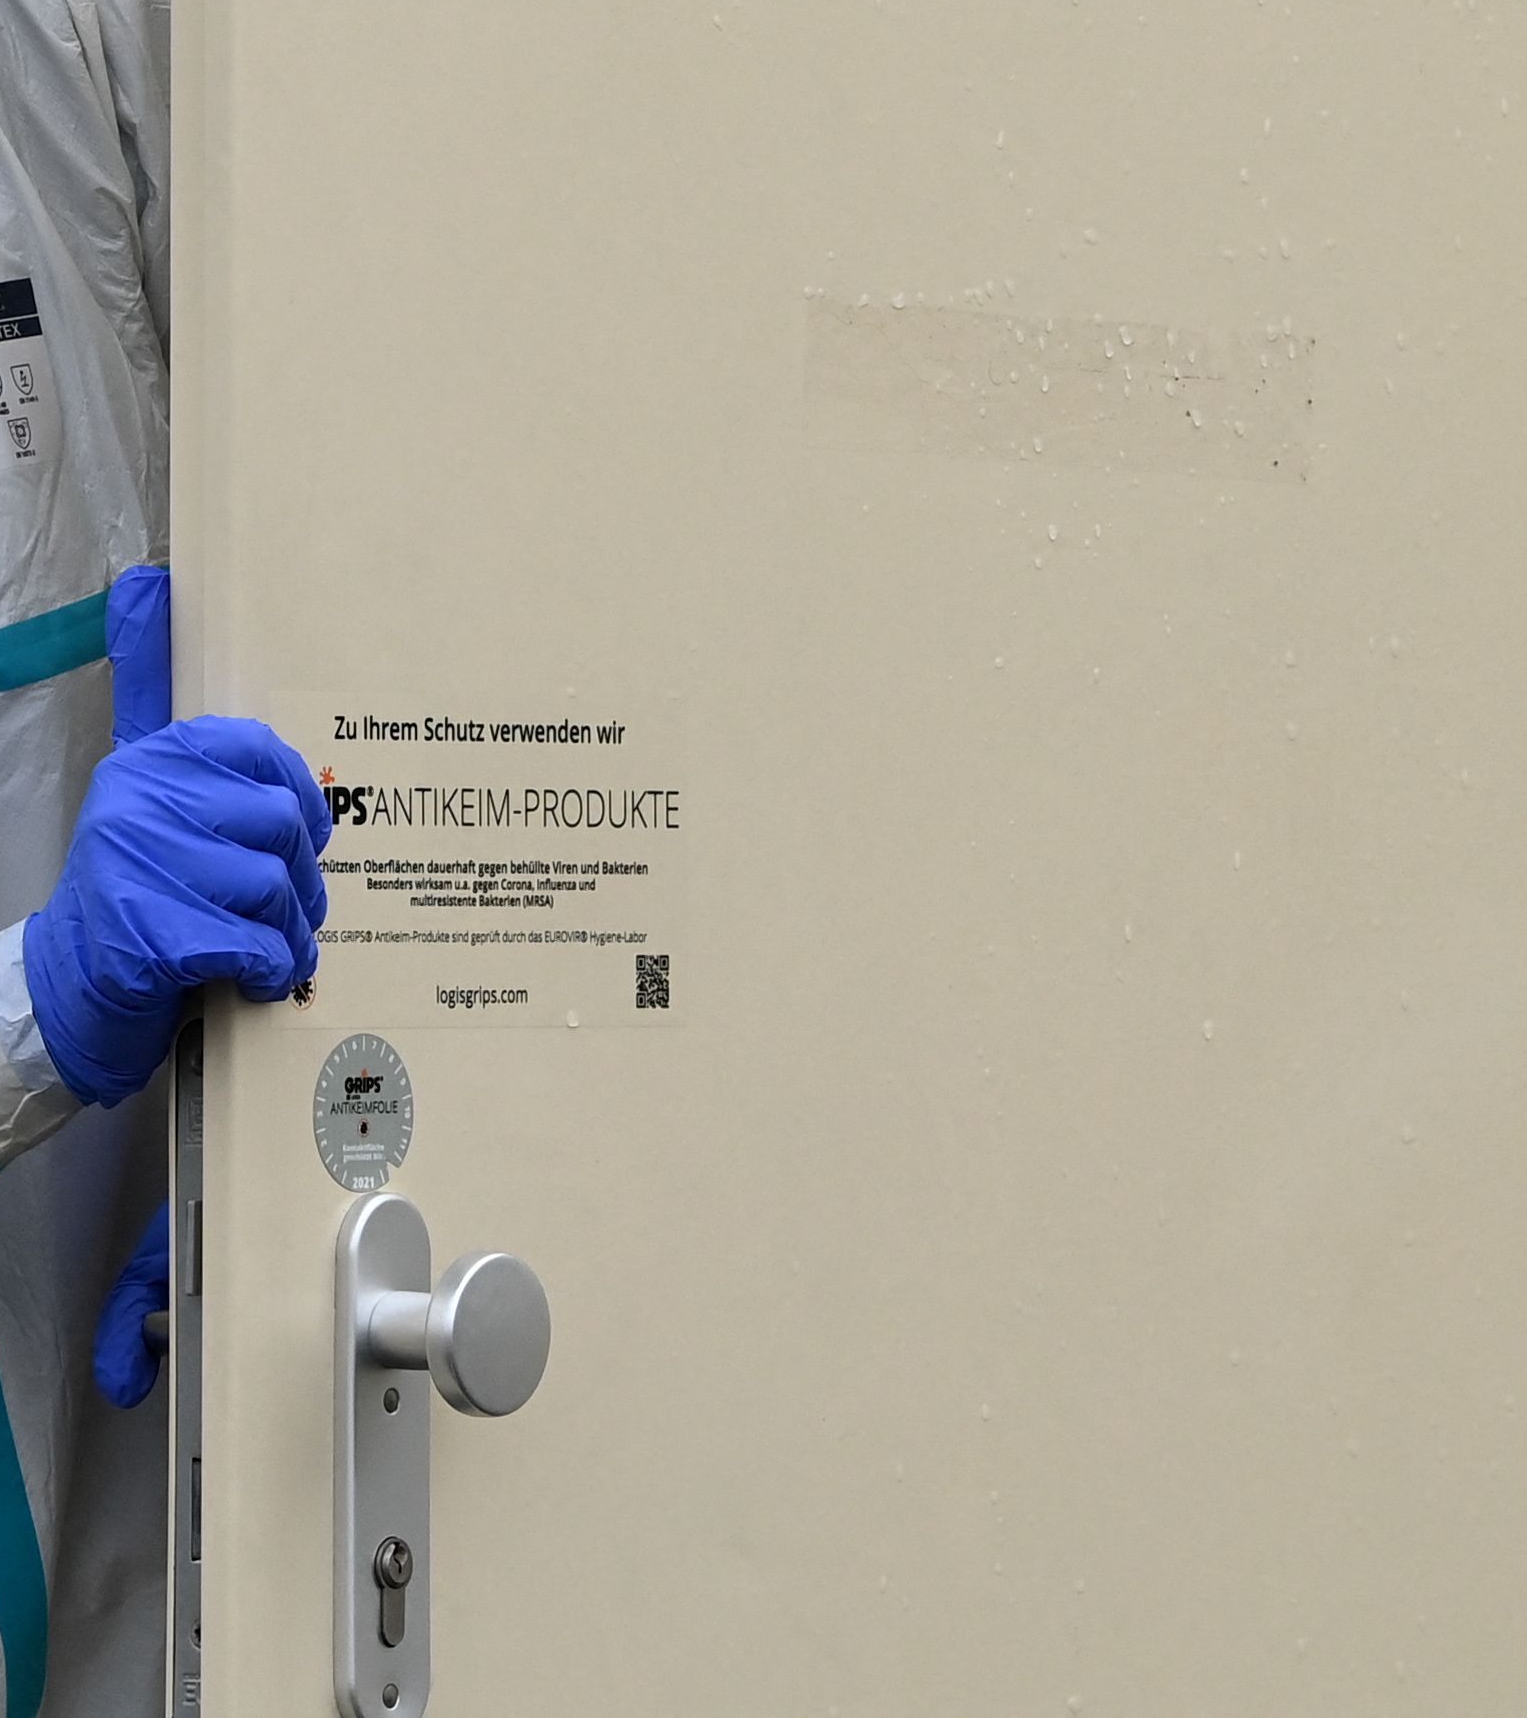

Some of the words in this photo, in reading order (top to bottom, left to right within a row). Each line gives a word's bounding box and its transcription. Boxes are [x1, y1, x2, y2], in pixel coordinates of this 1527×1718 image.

[333, 715, 358, 741] Zu
[363, 714, 419, 742] Ihrem
[423, 715, 486, 743] Schutz
[488, 717, 592, 745] verwenden
[595, 719, 626, 745] wir
[370, 786, 680, 830] ANTIKEIM-PRODUKTE
[363, 858, 425, 875] Oberflächen
[426, 858, 477, 875] dauerhaft
[477, 862, 508, 879] gegen
[551, 860, 579, 875] Viren
[580, 860, 600, 876] und
[601, 860, 649, 876] Bakterien
[366, 876, 414, 891] Besonders
[414, 876, 453, 891] wirksam
[471, 880, 500, 895] gegen
[500, 877, 536, 892] Corona,
[536, 877, 578, 892] Influenza
[578, 877, 597, 892] und
[409, 893, 478, 908] multiresistente
[478, 893, 522, 908] Bakterien
[522, 894, 555, 910] (MRSA)
[373, 929, 451, 944] Antikeim-Produkte
[451, 929, 470, 944] sind
[470, 929, 501, 947] geprüft
[501, 929, 527, 944] durch
[527, 929, 543, 944] das
[589, 930, 648, 947] Hygiene-Labor
[436, 984, 529, 1010] logisgrips.com
[330, 1100, 398, 1115] ANTIKEIMFOLIE
[352, 1176, 375, 1189] 2021
